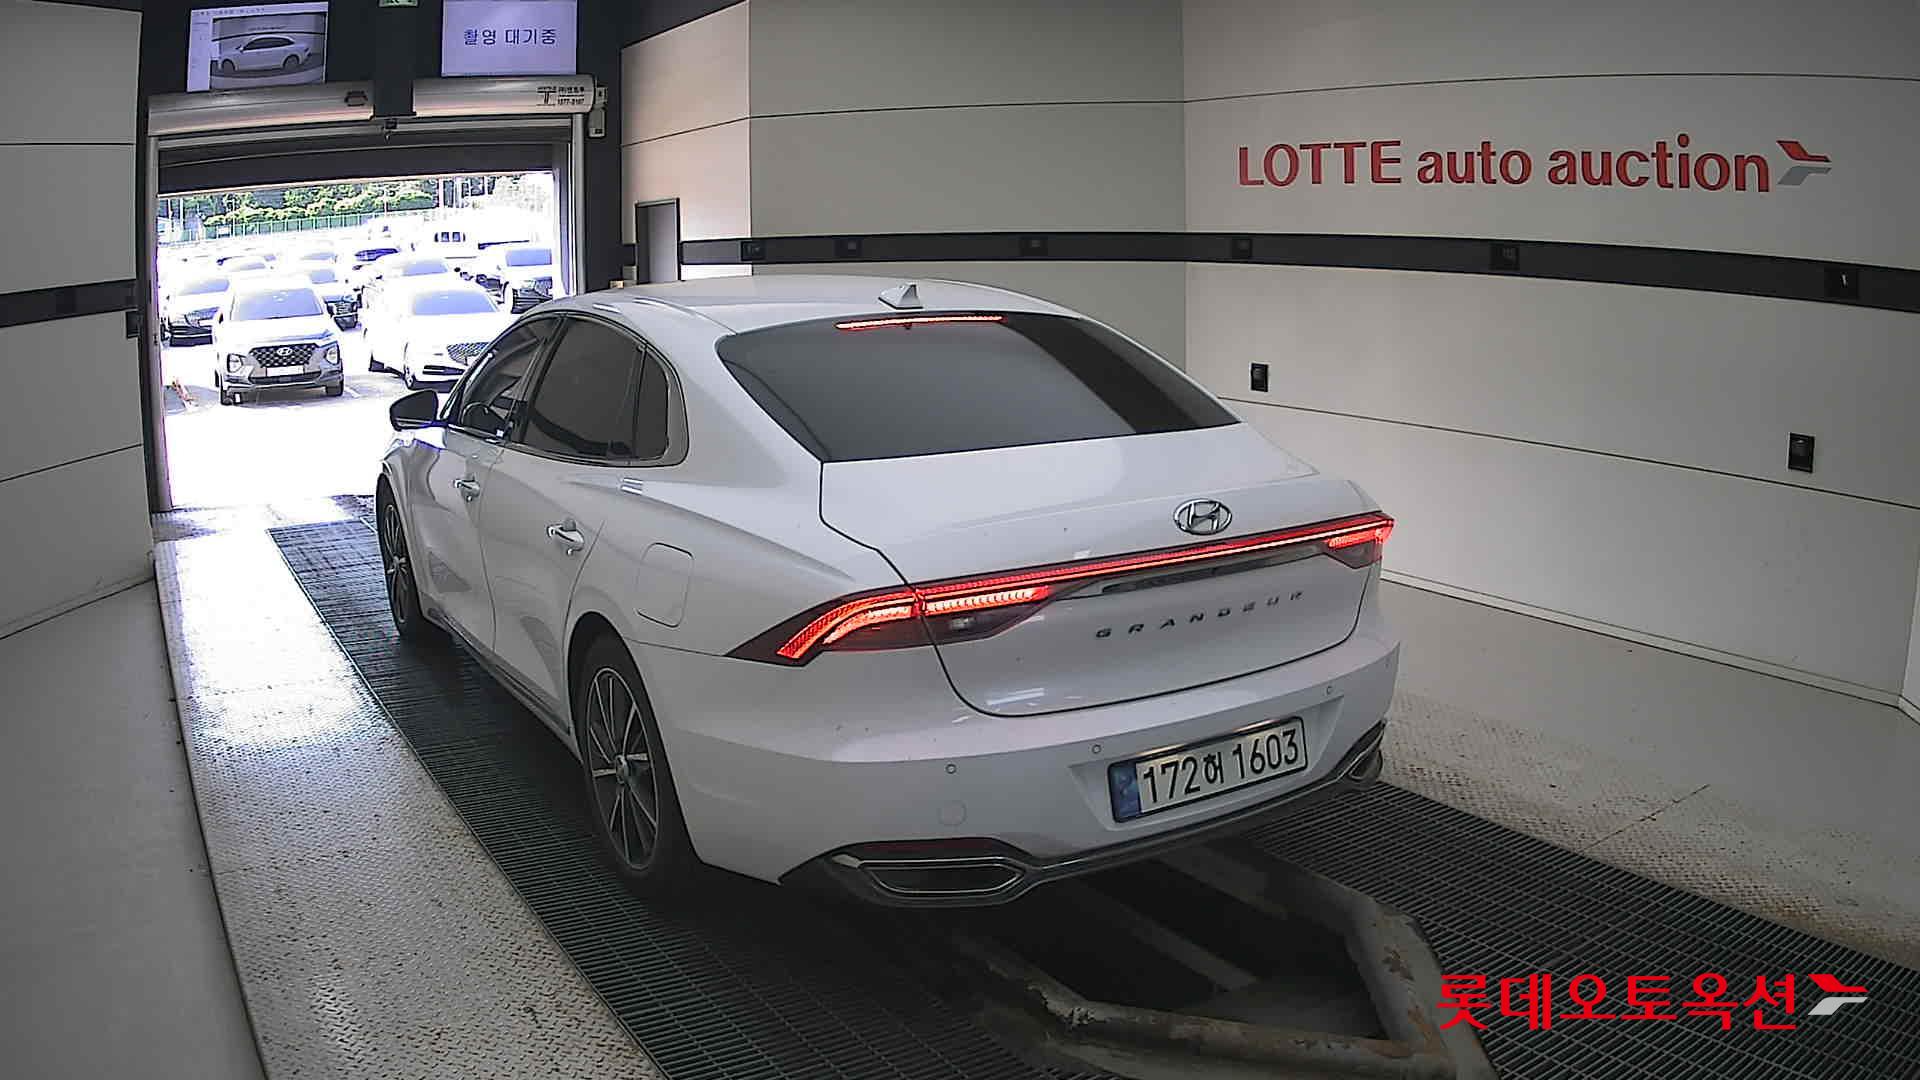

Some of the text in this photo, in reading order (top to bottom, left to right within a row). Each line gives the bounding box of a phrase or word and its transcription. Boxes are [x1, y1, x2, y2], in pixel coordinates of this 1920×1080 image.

[506, 29, 556, 46] 대기중
[1240, 133, 1769, 192] LOTTE auto auction
[1095, 591, 1305, 639] GRANDEUR
[1143, 728, 1299, 804] 172허 1603
